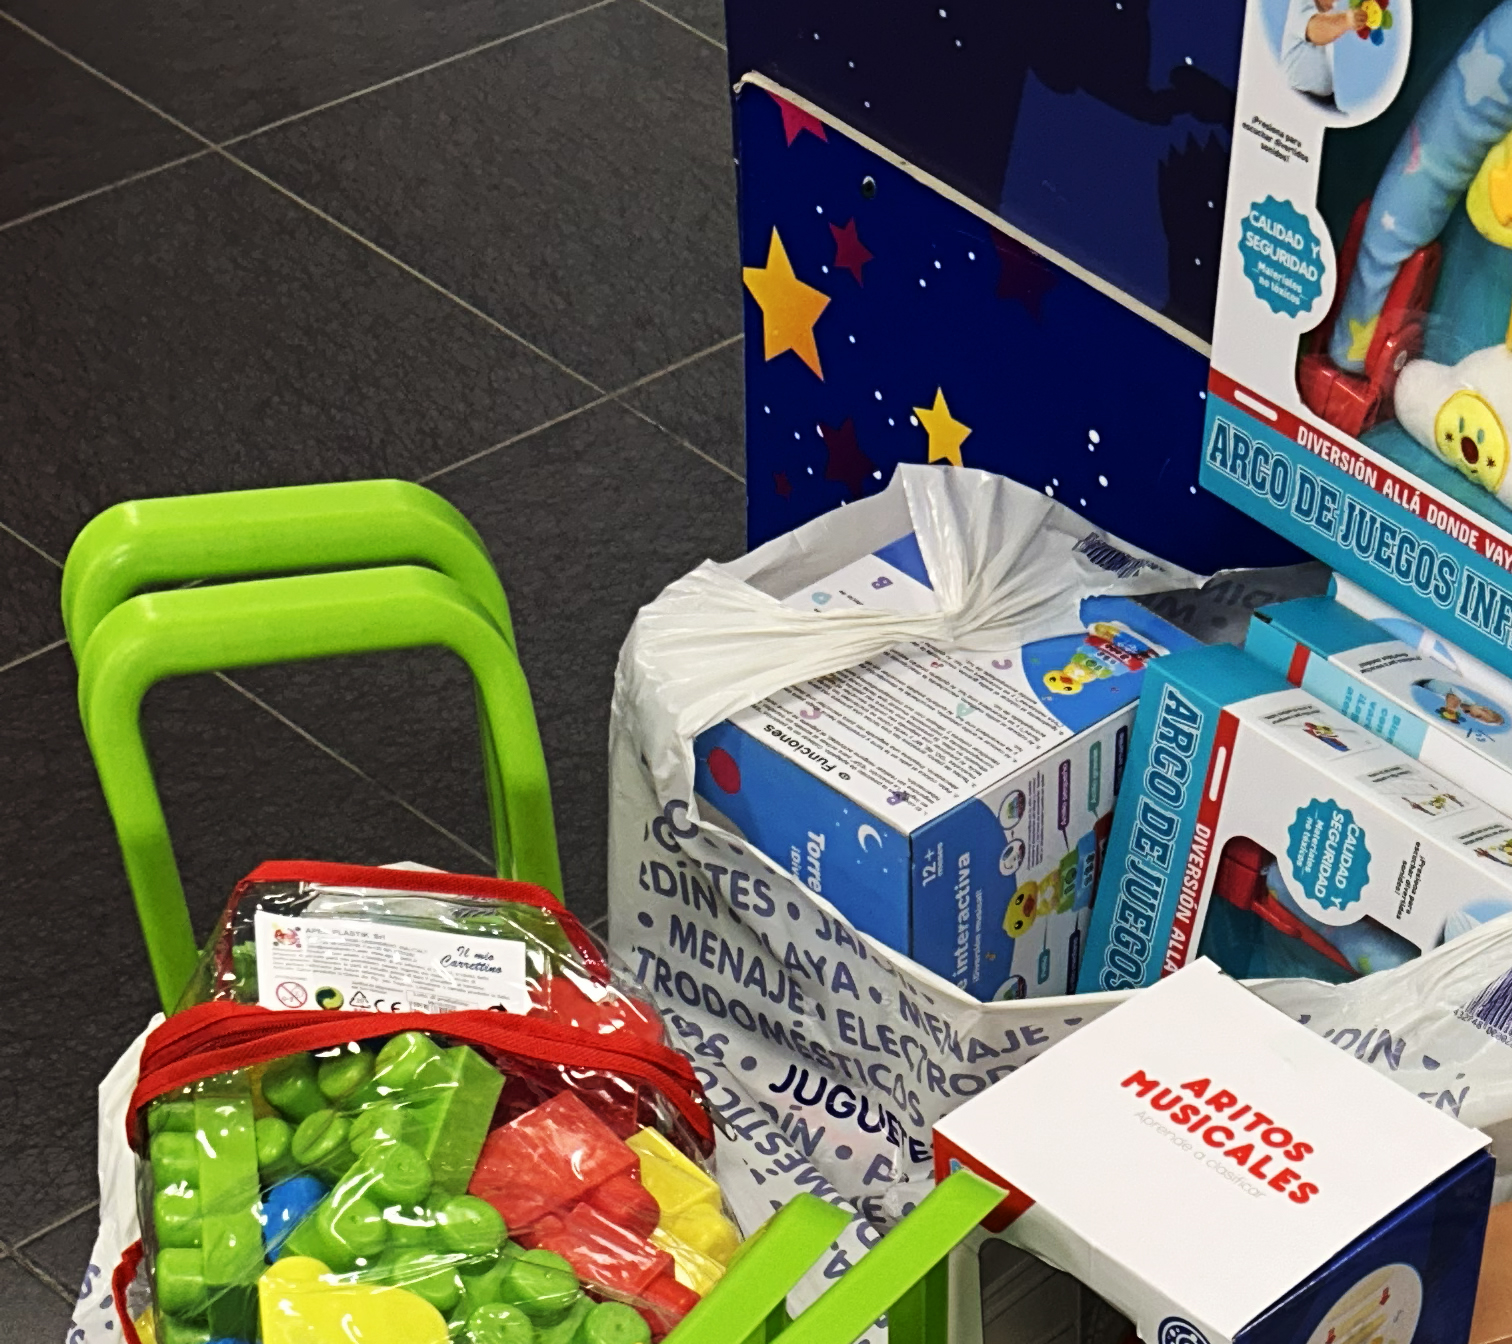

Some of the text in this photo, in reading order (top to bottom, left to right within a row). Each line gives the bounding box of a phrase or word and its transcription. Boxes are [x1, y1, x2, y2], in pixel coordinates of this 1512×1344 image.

[1246, 231, 1318, 282] SEGURIDAD
[1250, 210, 1320, 259] CALIDAD Y
[1207, 417, 1293, 508] ARCO
[1292, 465, 1342, 539] DE
[1338, 494, 1458, 609] JUEGOS
[1298, 426, 1378, 487] DIVERSIÓN
[1382, 479, 1421, 515] ALLÁ
[1427, 504, 1478, 551] DONDE
[763, 723, 836, 774] Funciones
[806, 831, 825, 894] Torre
[922, 848, 934, 888] 12+
[1101, 682, 1205, 992] ARCO DE JUEGOS
[1174, 823, 1211, 929] DIVERSIÓN
[1315, 810, 1345, 898] SEGURIDAD
[1331, 823, 1360, 910] CALIDAD Y
[954, 851, 971, 980] interactiva
[669, 914, 812, 1014] MENAJE
[1120, 1069, 1320, 1206] MUSICALES
[1134, 1109, 1267, 1200] Aprende a clasificar
[1180, 1077, 1314, 1164] ARITOS
